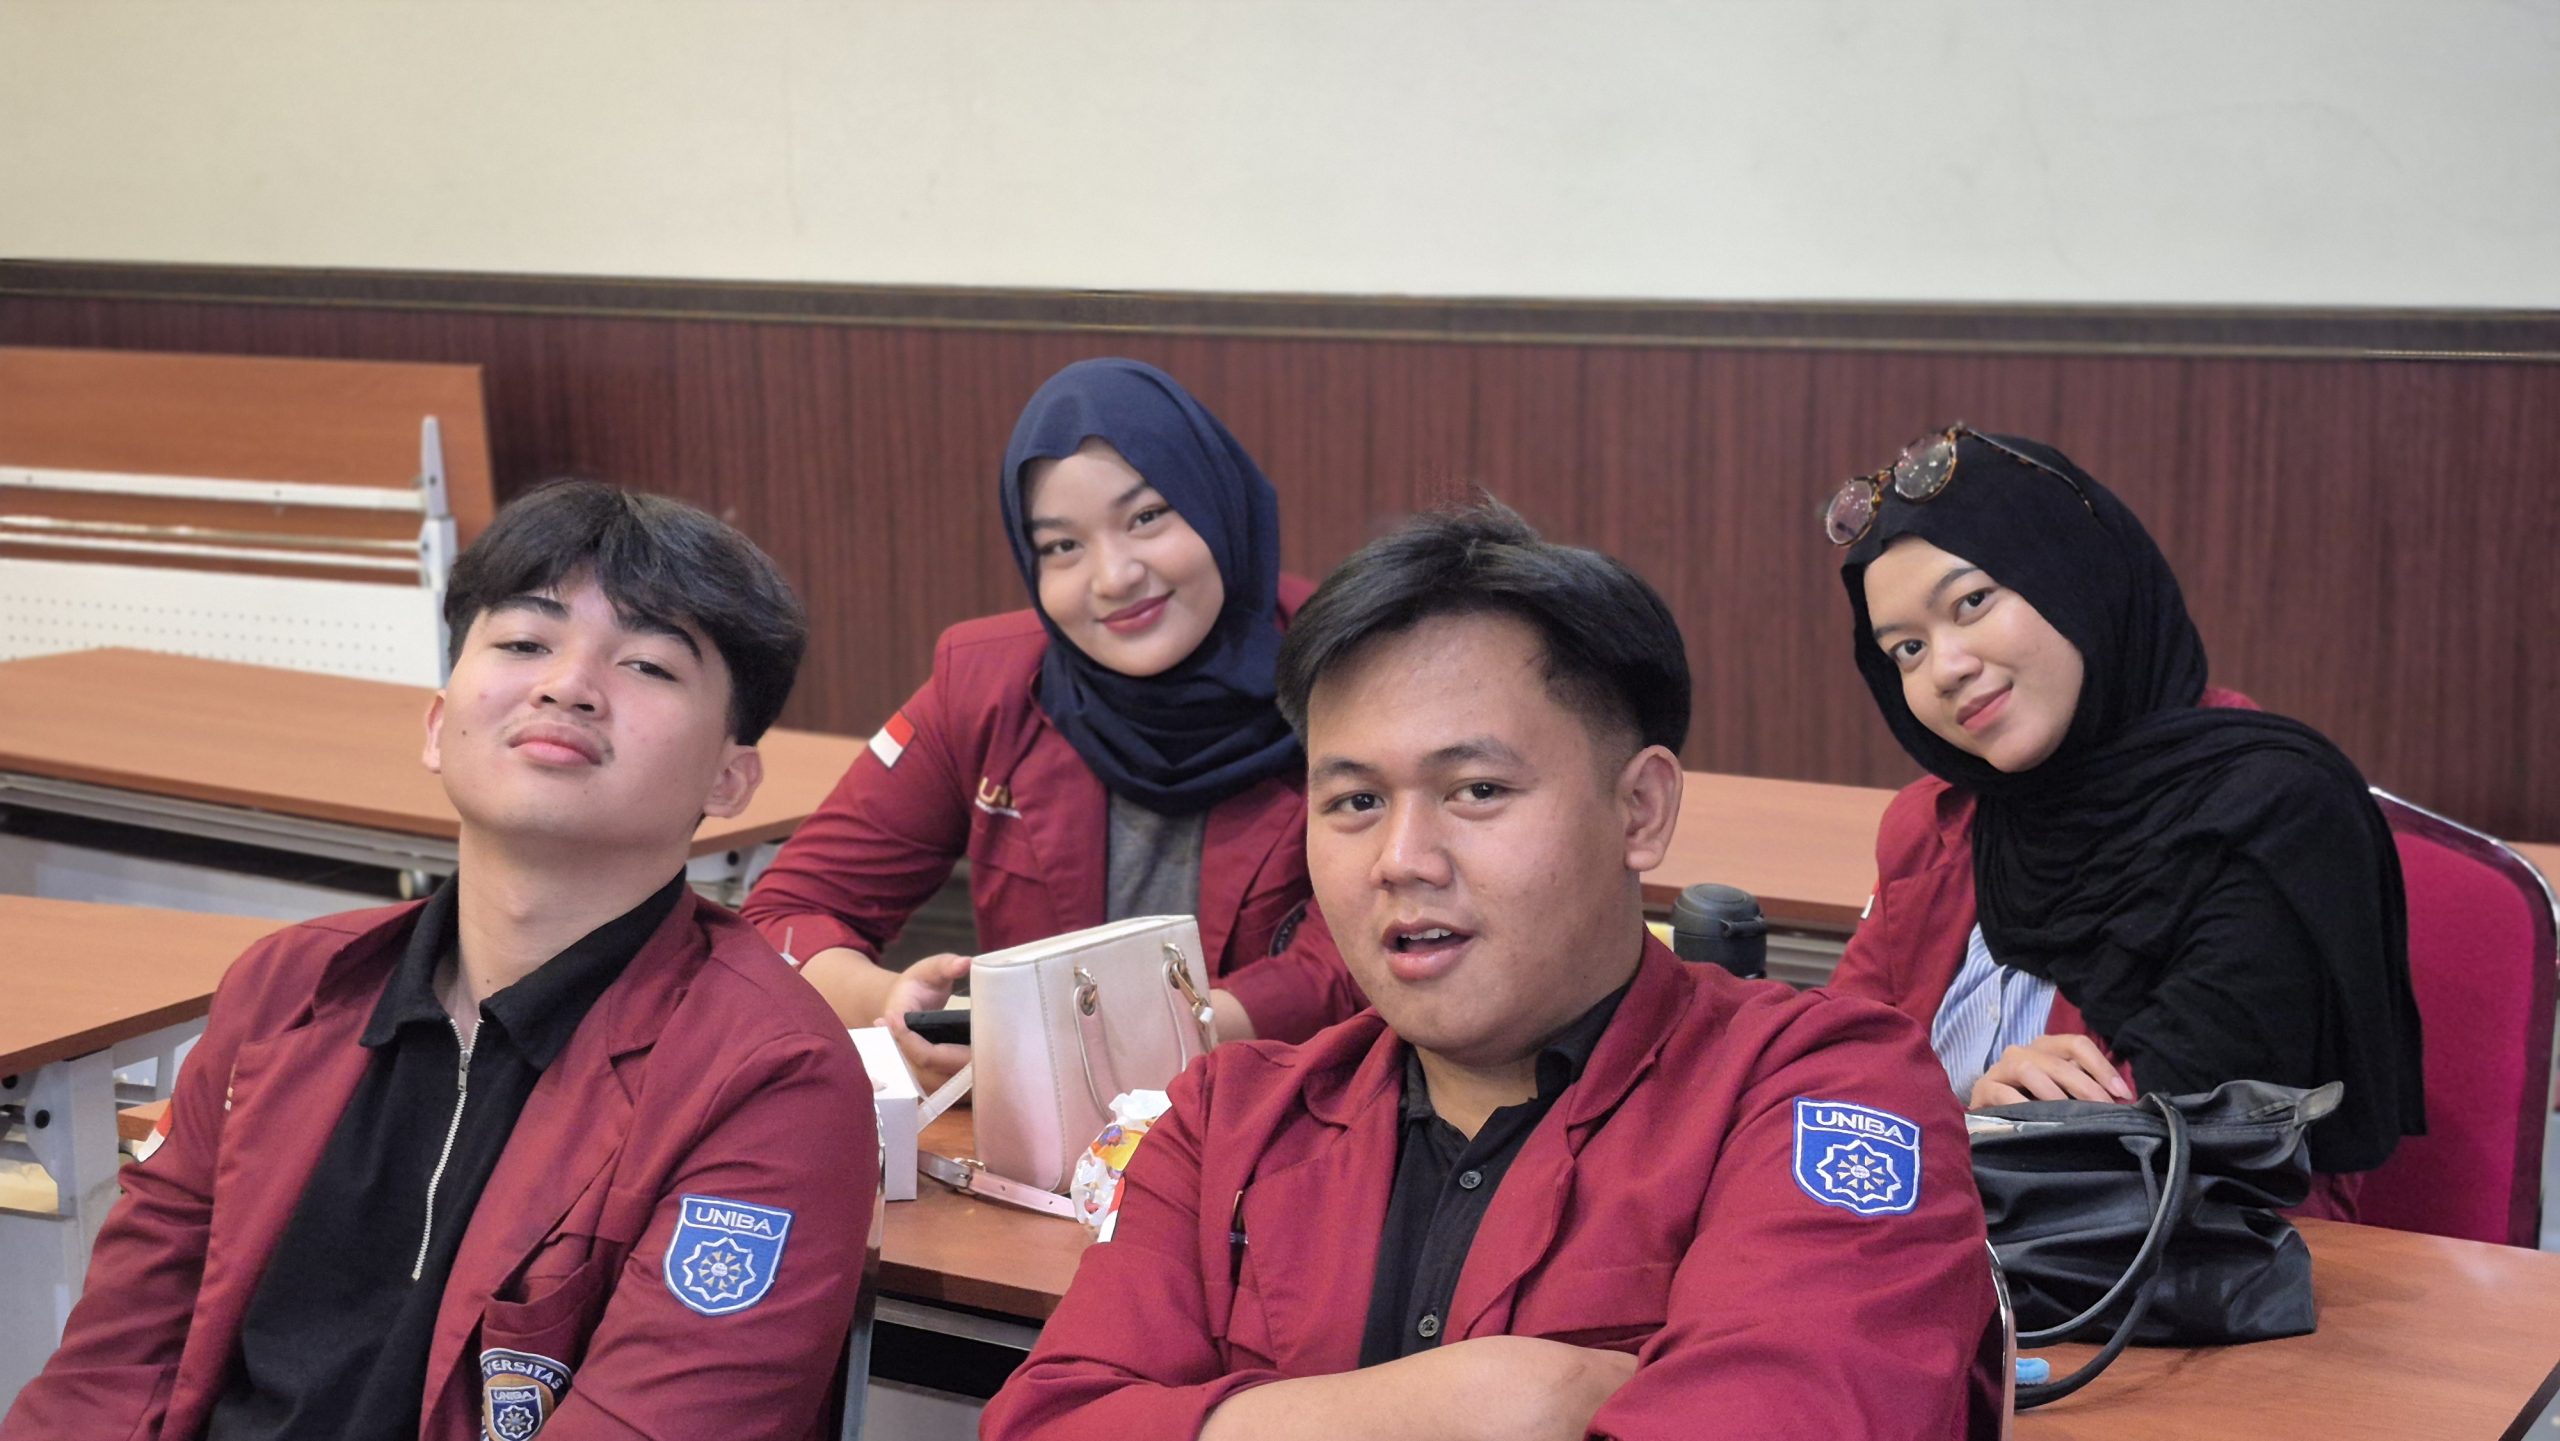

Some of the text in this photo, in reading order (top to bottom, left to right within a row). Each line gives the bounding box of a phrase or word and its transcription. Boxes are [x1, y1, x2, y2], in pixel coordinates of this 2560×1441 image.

[1815, 1109, 1906, 1144] UNIBA
[695, 1206, 773, 1236] UNIBA
[493, 1390, 534, 1401] UNIBA
